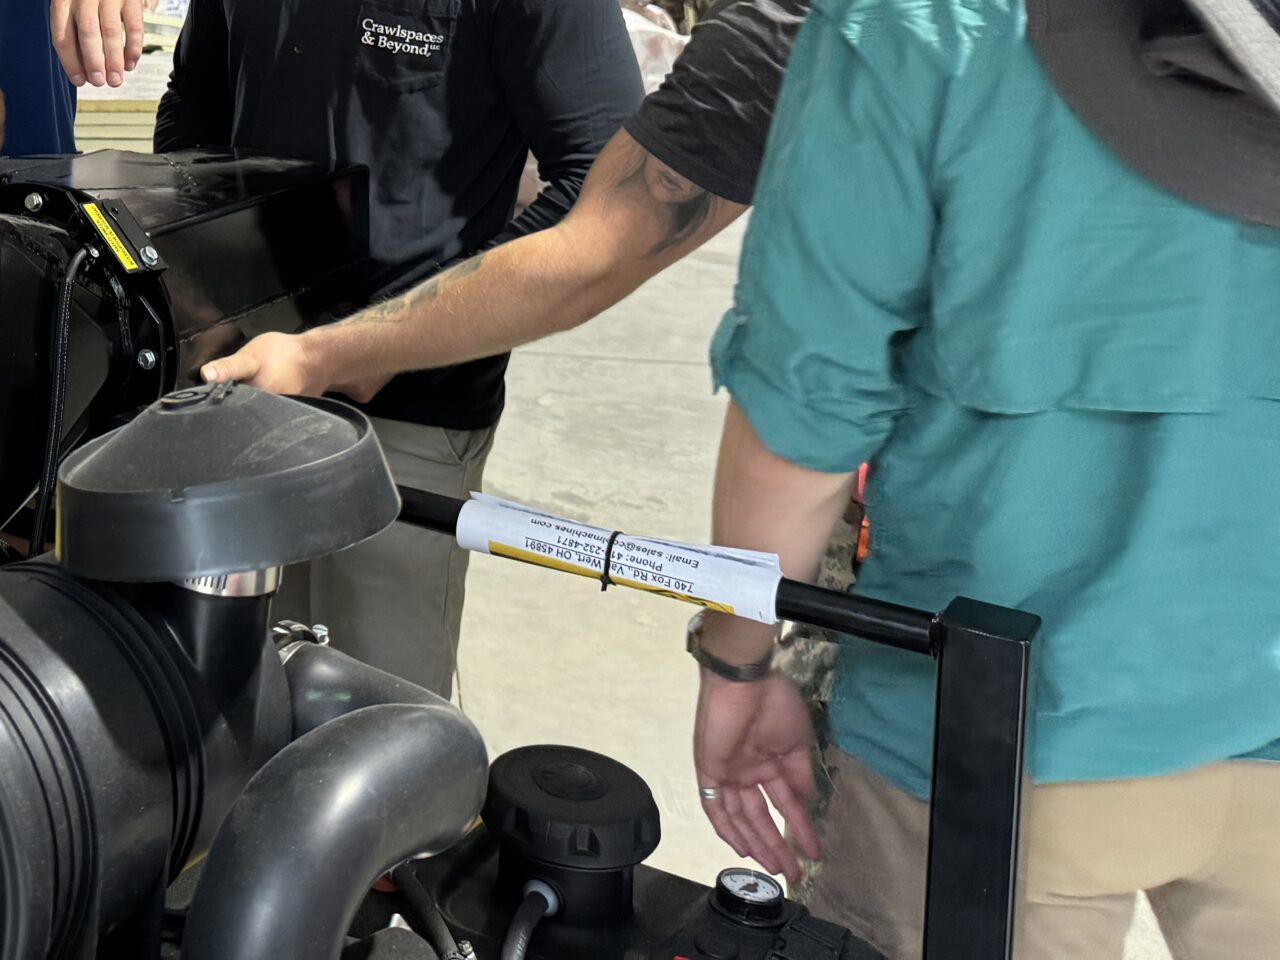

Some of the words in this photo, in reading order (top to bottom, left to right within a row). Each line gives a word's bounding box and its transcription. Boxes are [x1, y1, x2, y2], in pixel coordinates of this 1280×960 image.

[361, 31, 376, 46] &
[362, 18, 444, 44] Crawlspaces
[524, 538, 553, 556] 45891
[556, 536, 624, 560] 41-232-4871
[556, 547, 573, 560] OH
[575, 551, 602, 570] Wert,
[625, 555, 663, 572] Phone:
[665, 553, 700, 569] Email:
[608, 563, 625, 576] Va
[650, 574, 671, 589] Fox
[673, 580, 694, 593] 740
